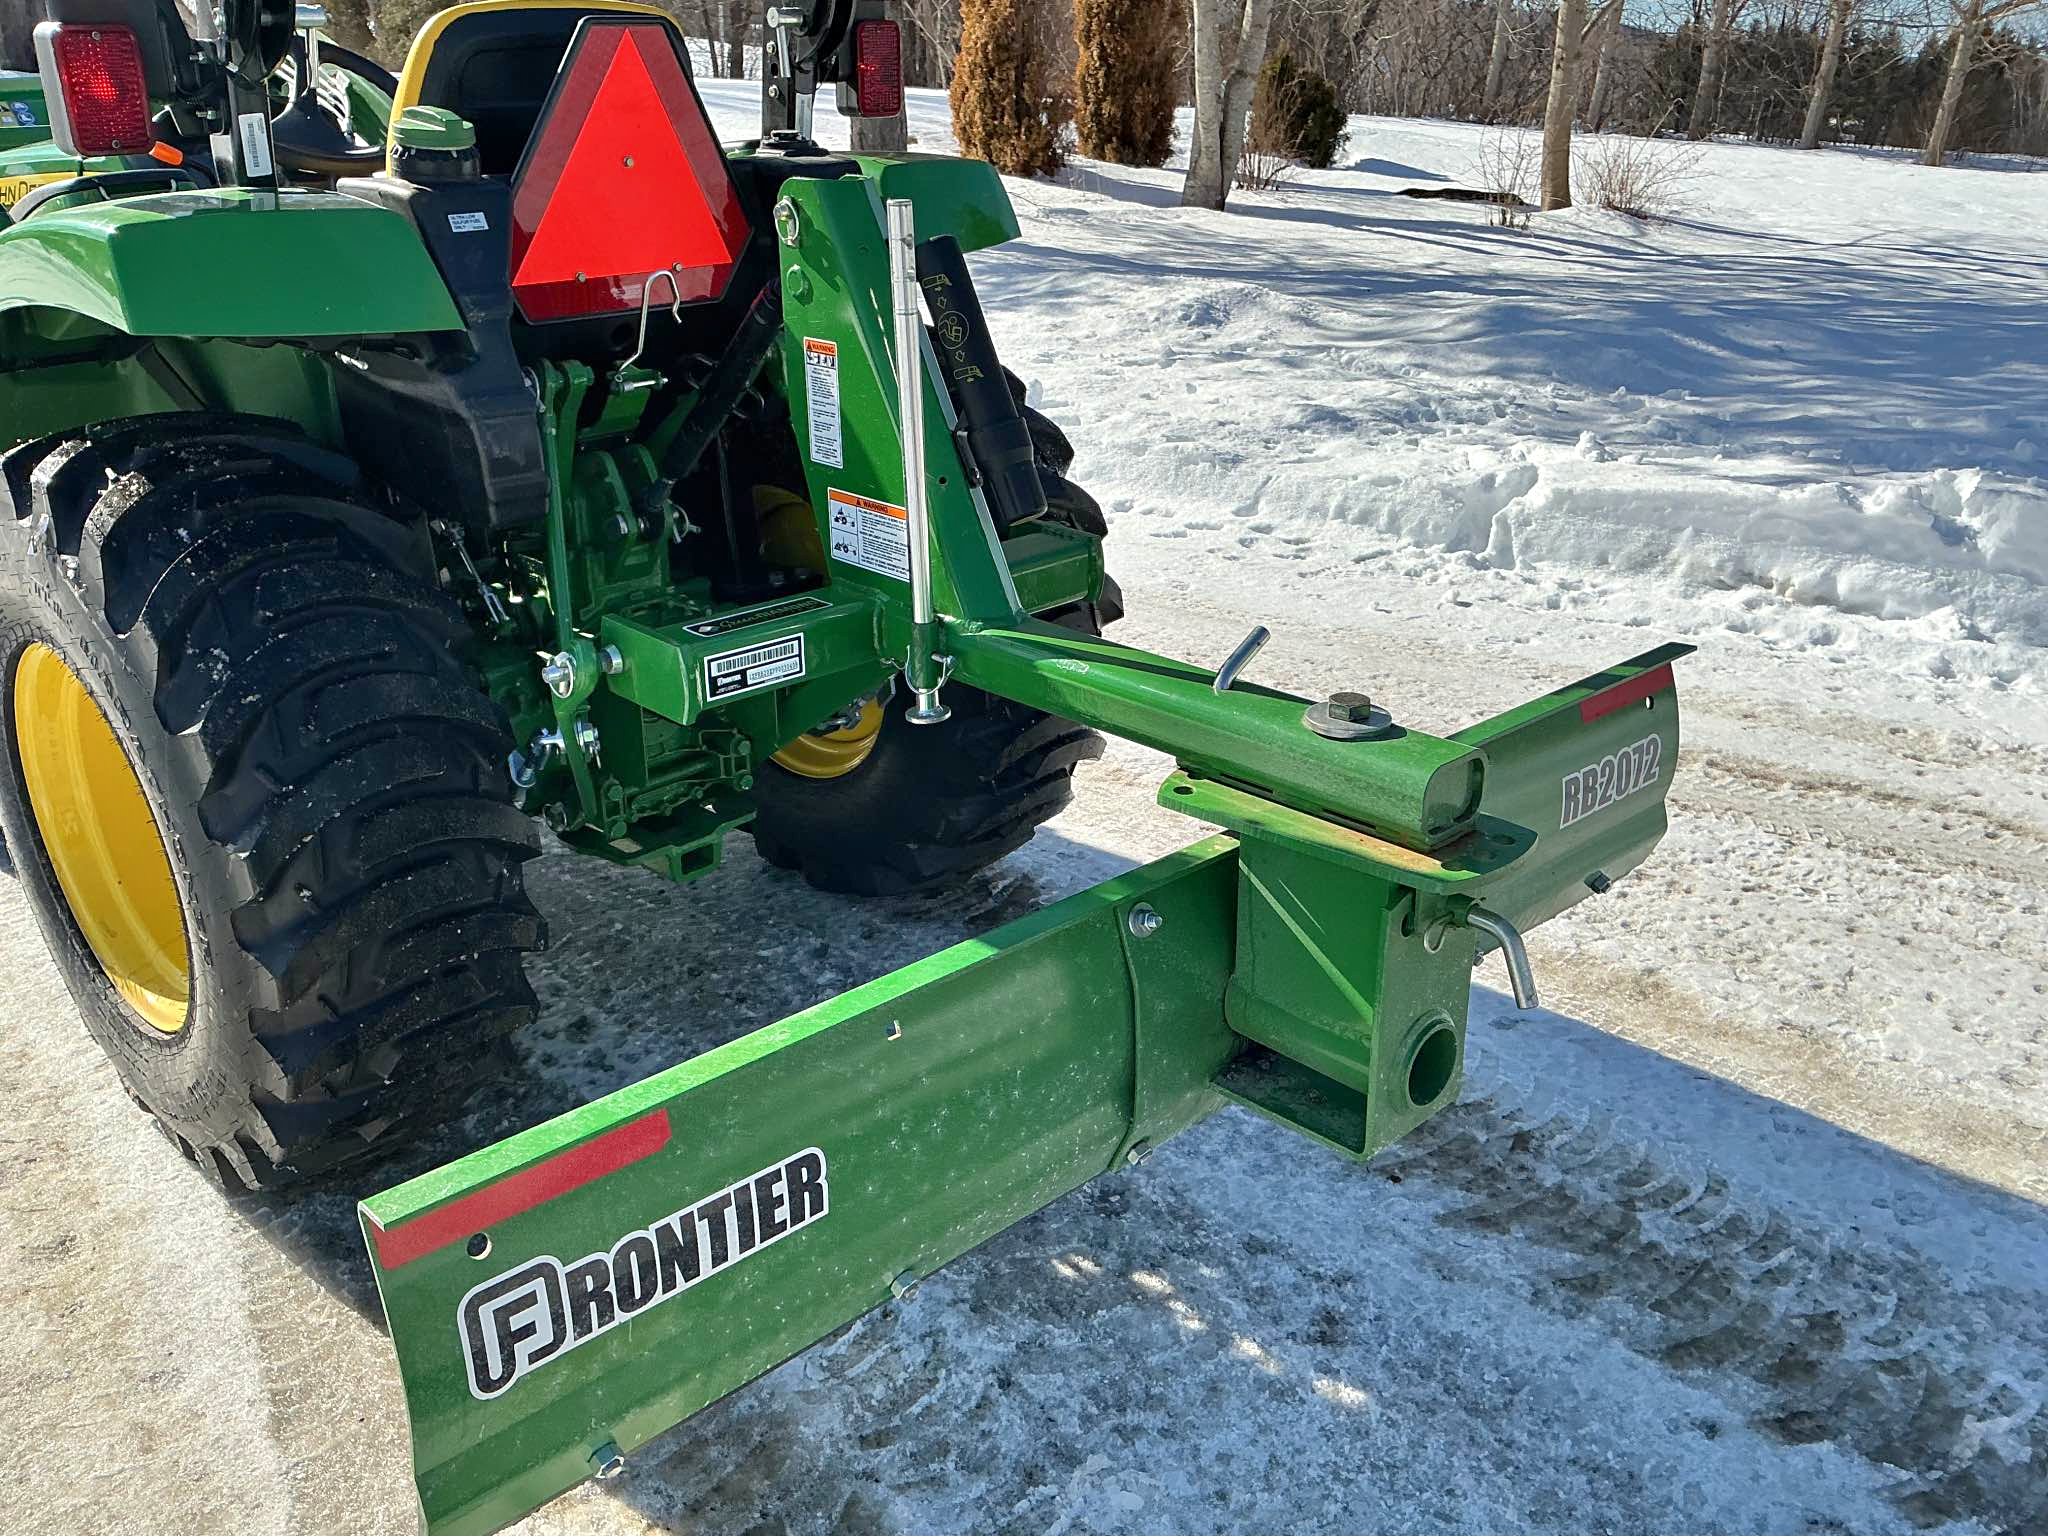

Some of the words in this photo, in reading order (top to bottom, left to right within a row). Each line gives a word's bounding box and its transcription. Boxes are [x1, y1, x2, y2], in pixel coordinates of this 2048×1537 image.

[0, 185, 16, 202] HN
[863, 500, 889, 514] WARNING
[1560, 734, 1661, 829] RB2072
[457, 1147, 829, 1400] FRONTIER
